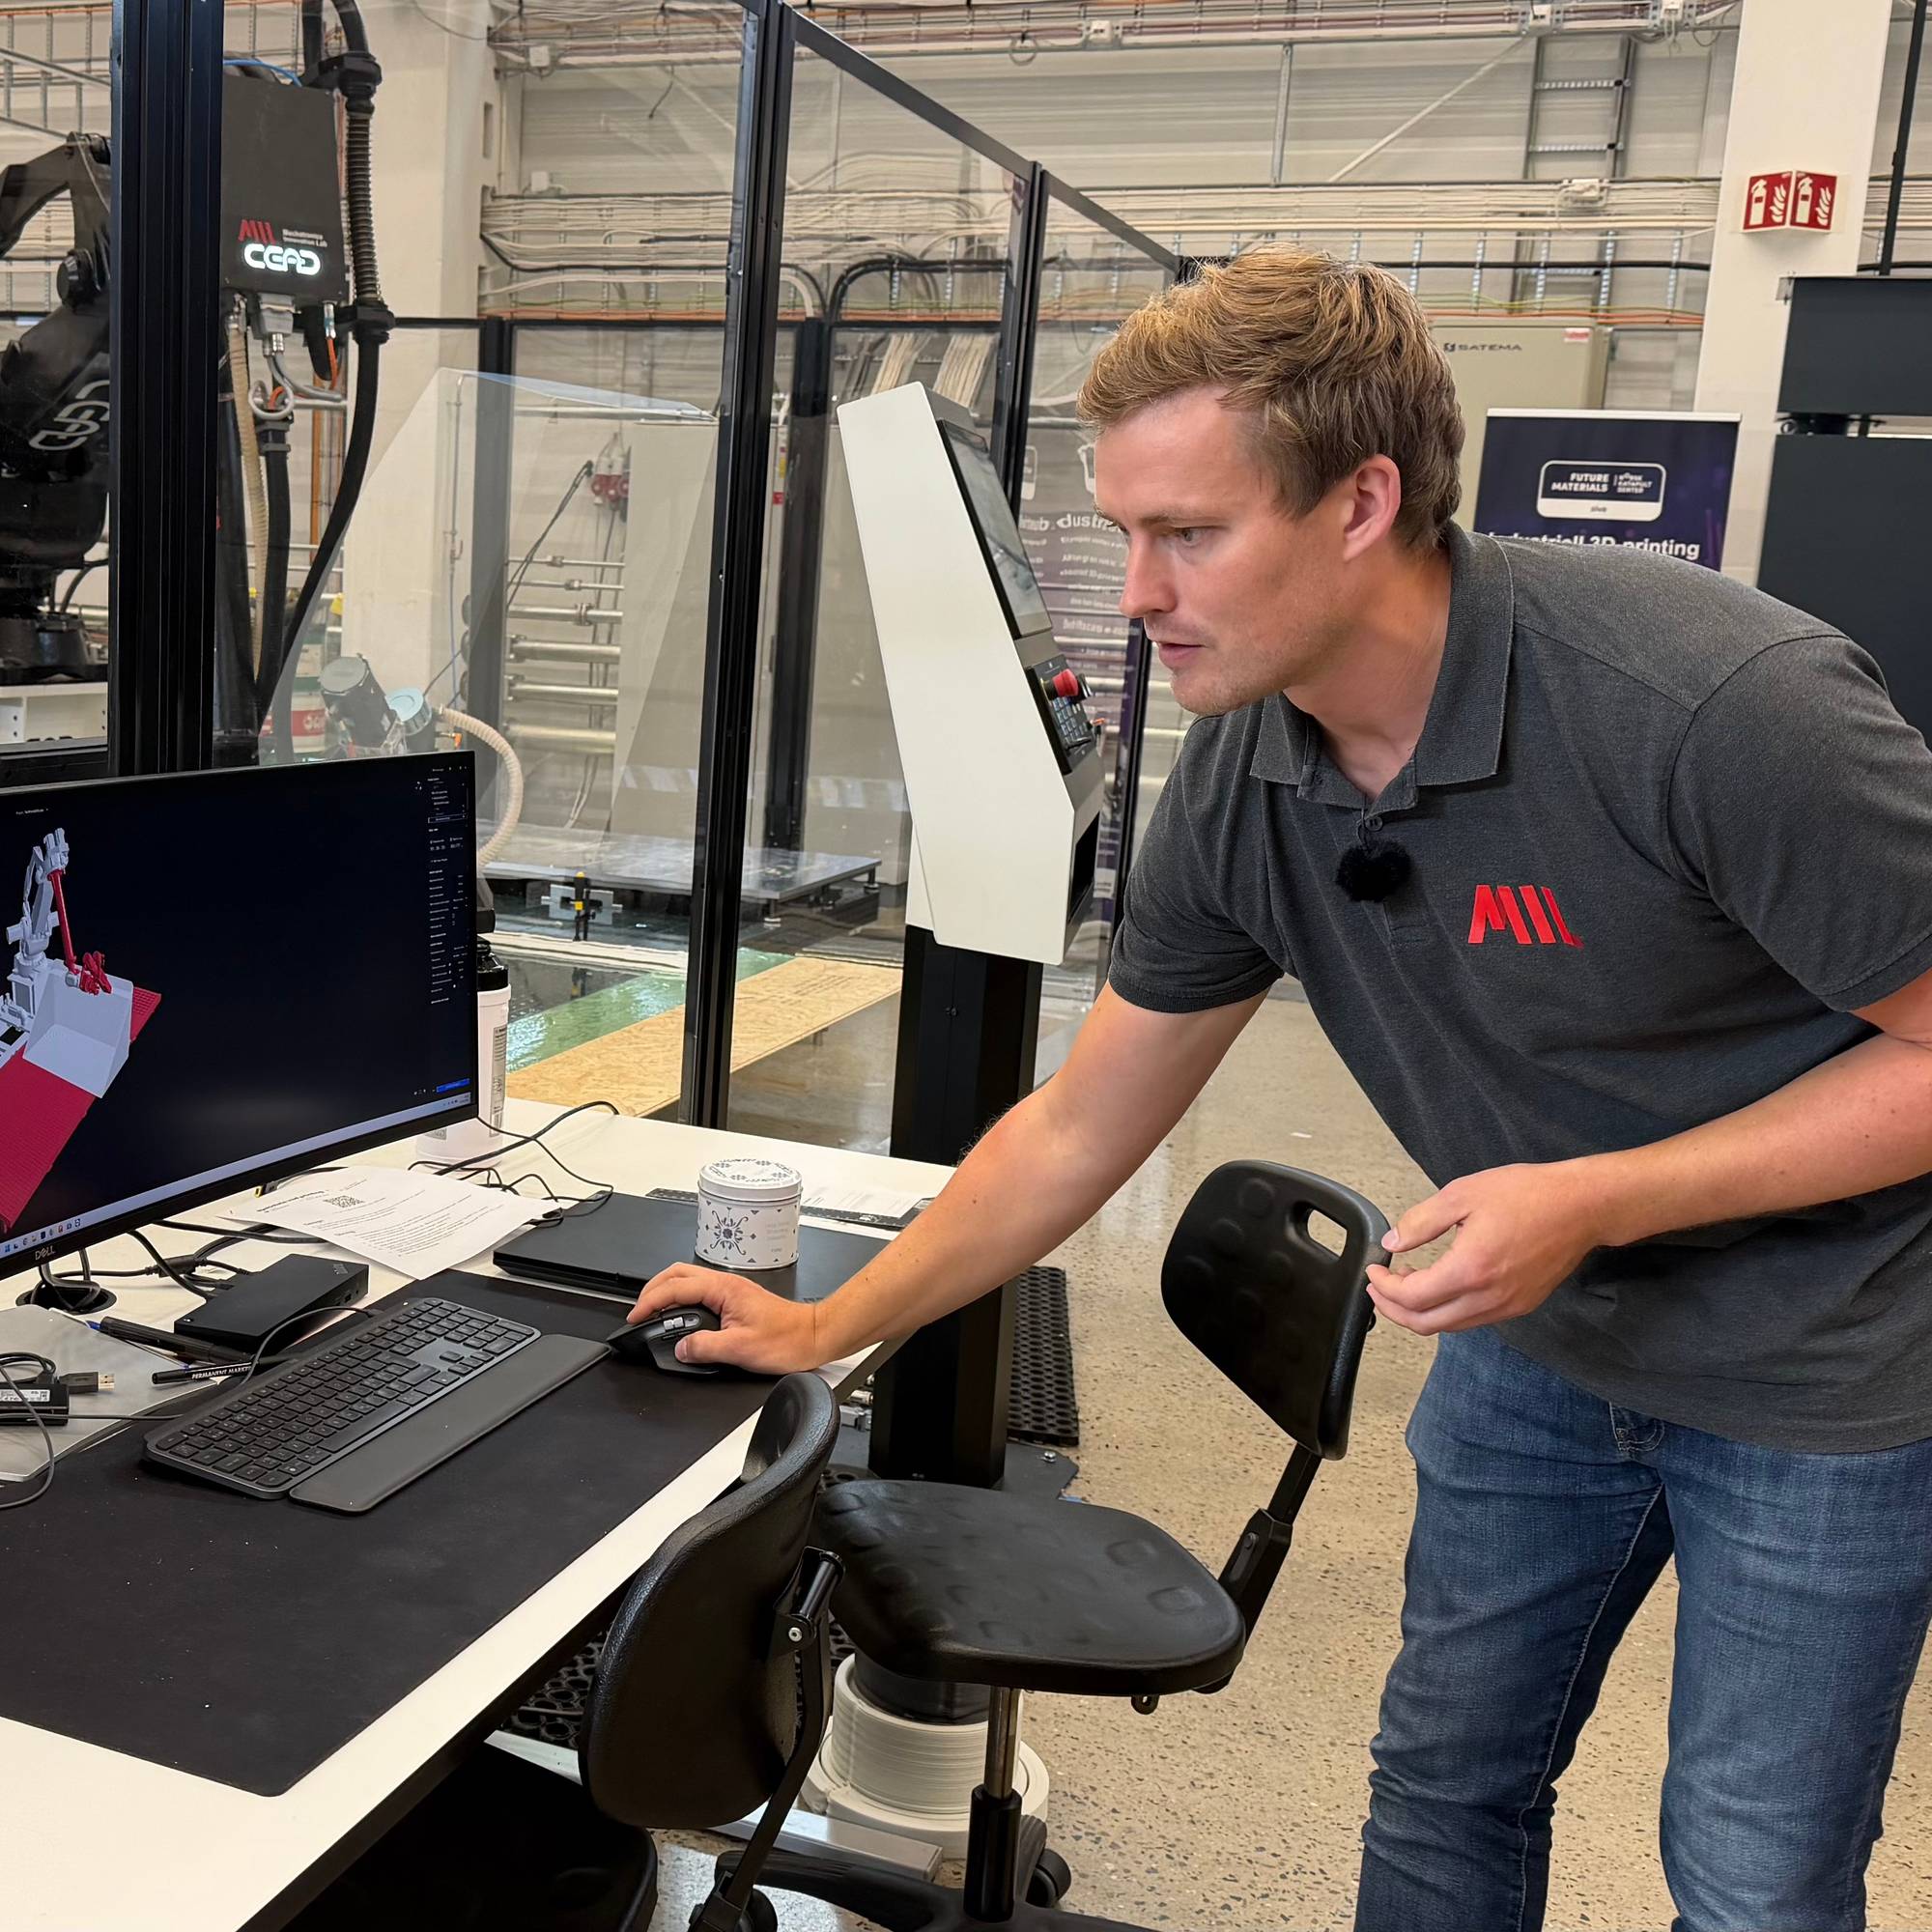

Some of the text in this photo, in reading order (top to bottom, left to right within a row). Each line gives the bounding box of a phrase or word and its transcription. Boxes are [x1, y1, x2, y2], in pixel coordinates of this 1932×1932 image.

[243, 243, 321, 276] CEAD
[1458, 343, 1523, 352] SATEMA
[1570, 472, 1610, 483] FUTURE
[1550, 482, 1608, 493] MATERIALS
[35, 1245, 56, 1261] DELL
[191, 1369, 228, 1379] PERMANENT
